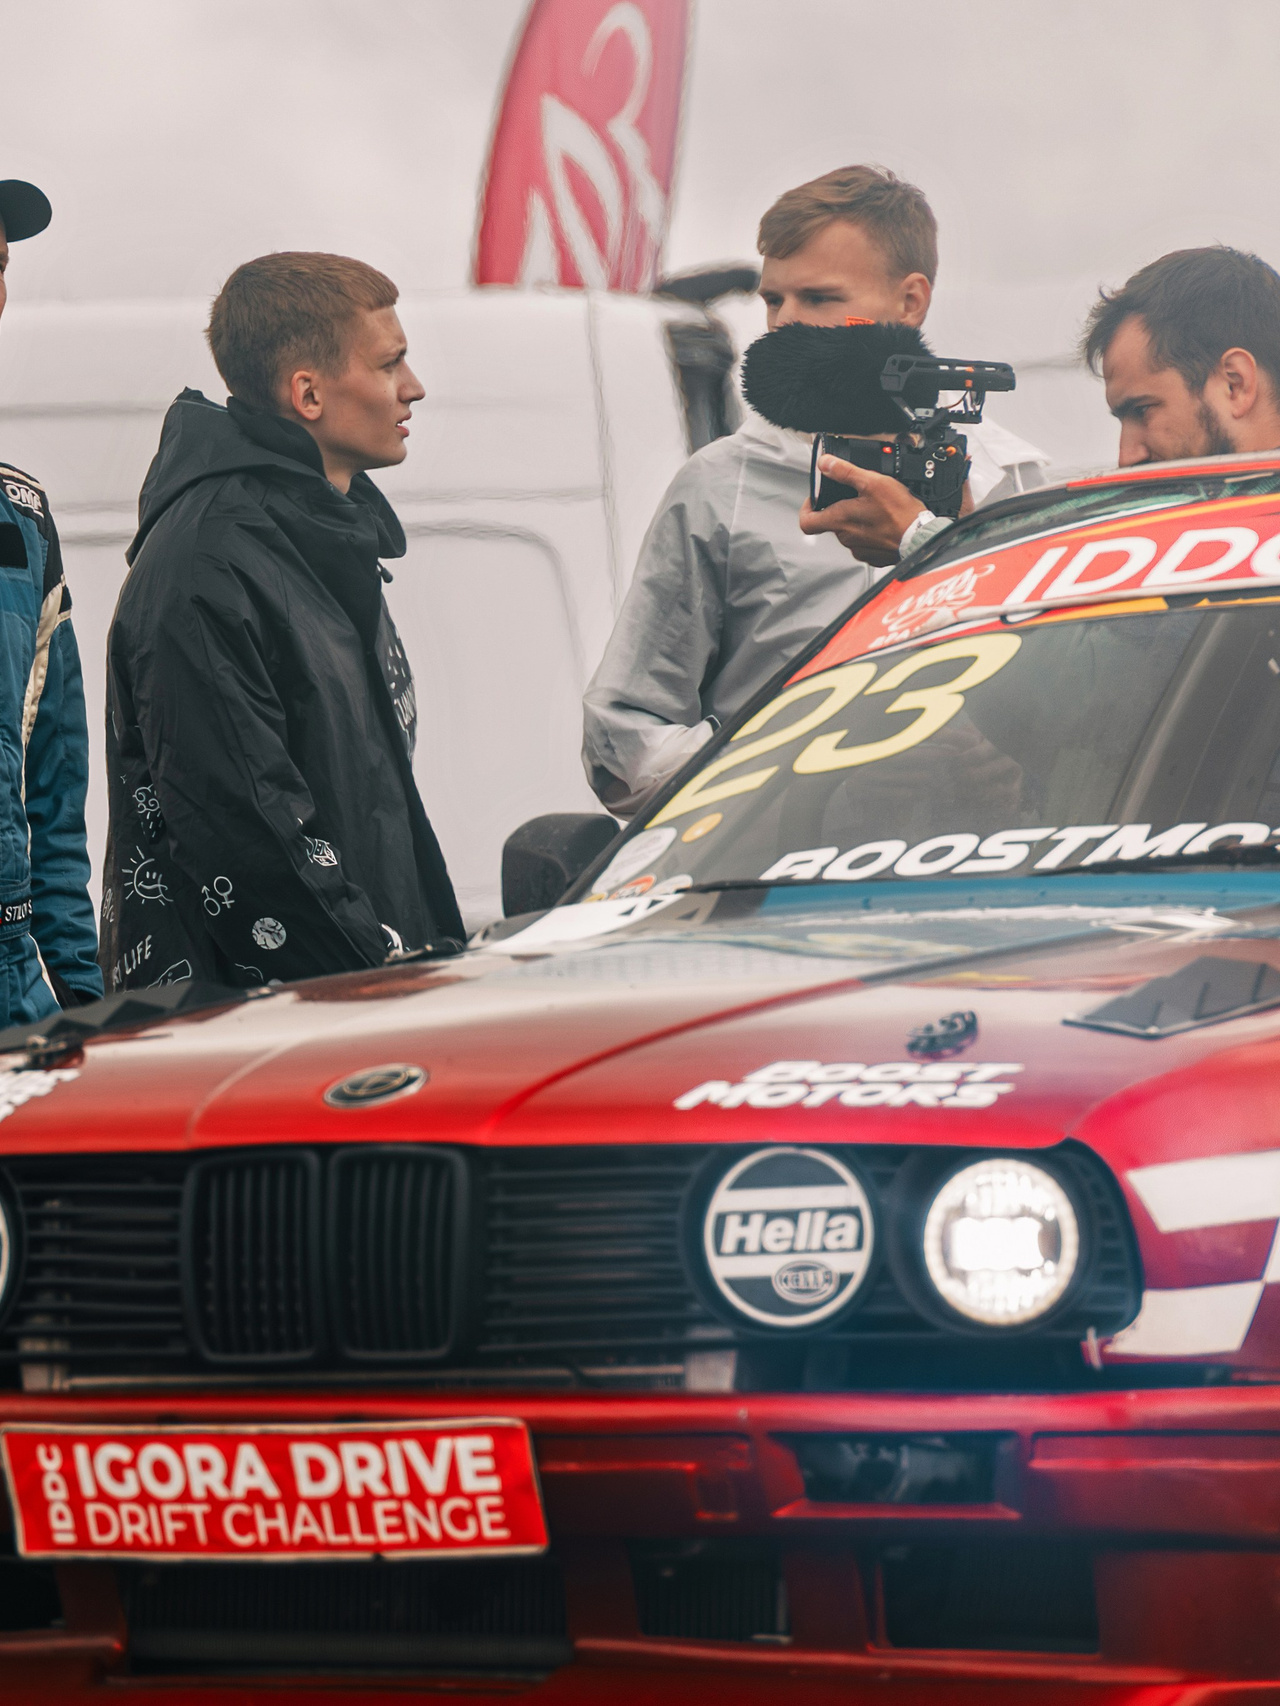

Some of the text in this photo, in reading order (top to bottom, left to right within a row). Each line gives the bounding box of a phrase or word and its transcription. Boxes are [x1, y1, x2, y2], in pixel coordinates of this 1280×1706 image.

[5, 484, 42, 510] OMP
[645, 632, 1022, 829] 23
[124, 934, 153, 975] LIFE
[742, 1060, 1025, 1084] BOOST
[673, 1080, 1016, 1111] MOTORS
[719, 1211, 860, 1254] Hella
[72, 1434, 503, 1500] IGORA DRIVE
[36, 1443, 78, 1545] IDDC
[84, 1496, 512, 1548] DRIFT CHALLENGE
